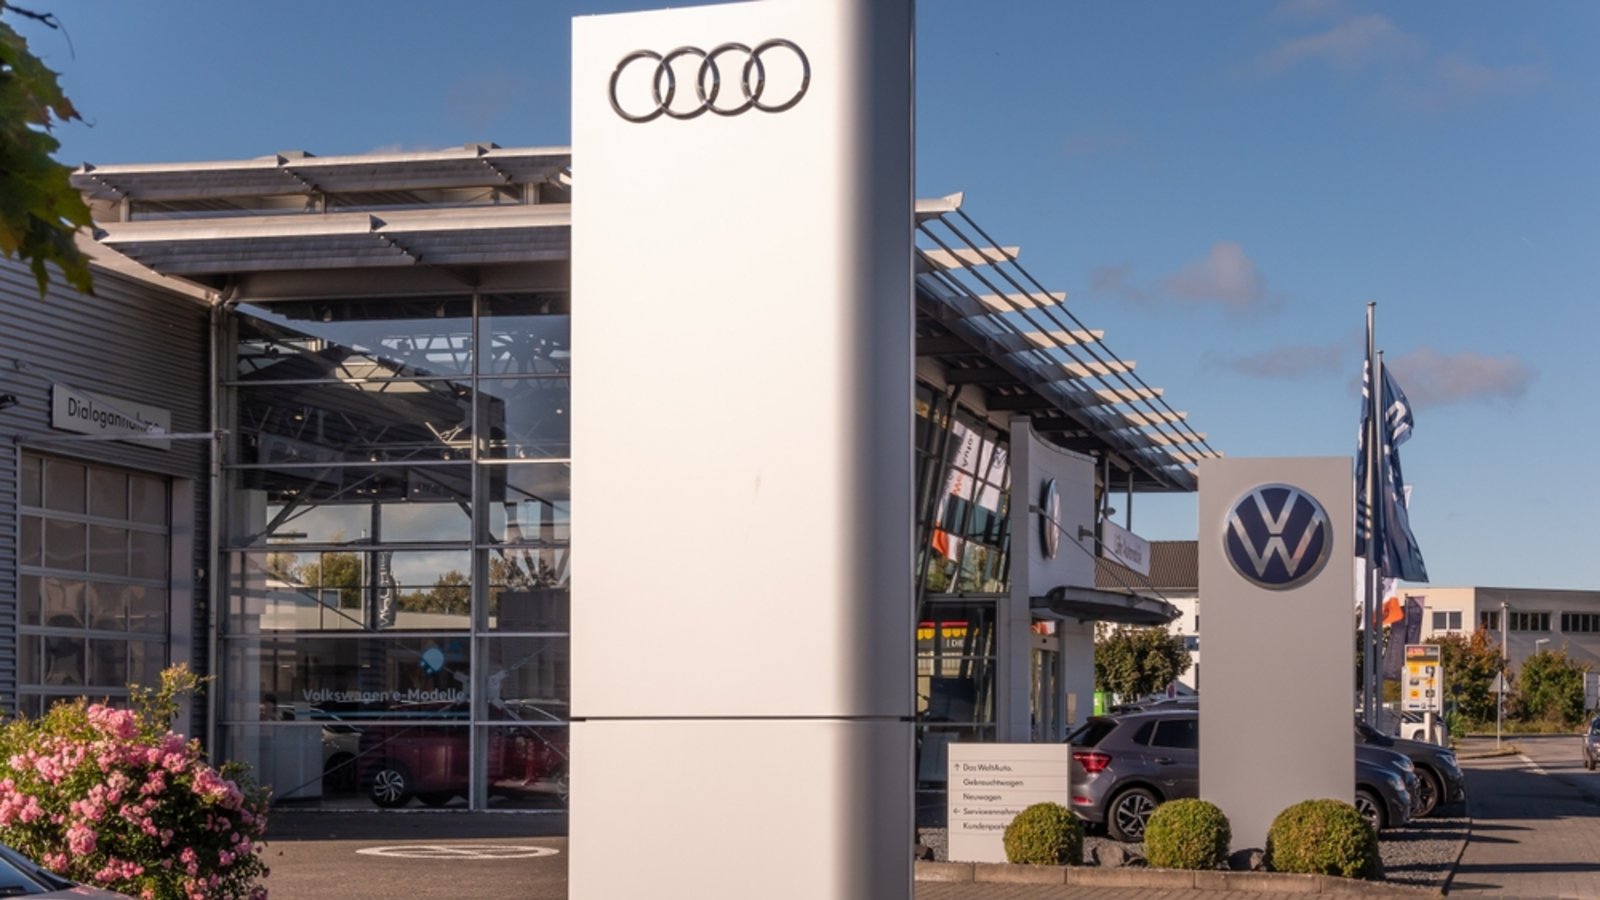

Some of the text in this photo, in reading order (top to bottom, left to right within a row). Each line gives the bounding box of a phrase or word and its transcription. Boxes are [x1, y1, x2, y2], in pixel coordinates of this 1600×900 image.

[302, 688, 465, 704] Volkswagen e-Modelle
[963, 763, 977, 771] Das
[963, 779, 1024, 788] Gebrauchtwagen
[963, 793, 1002, 802] Neuwagen
[963, 822, 1004, 831] Kundenpark
